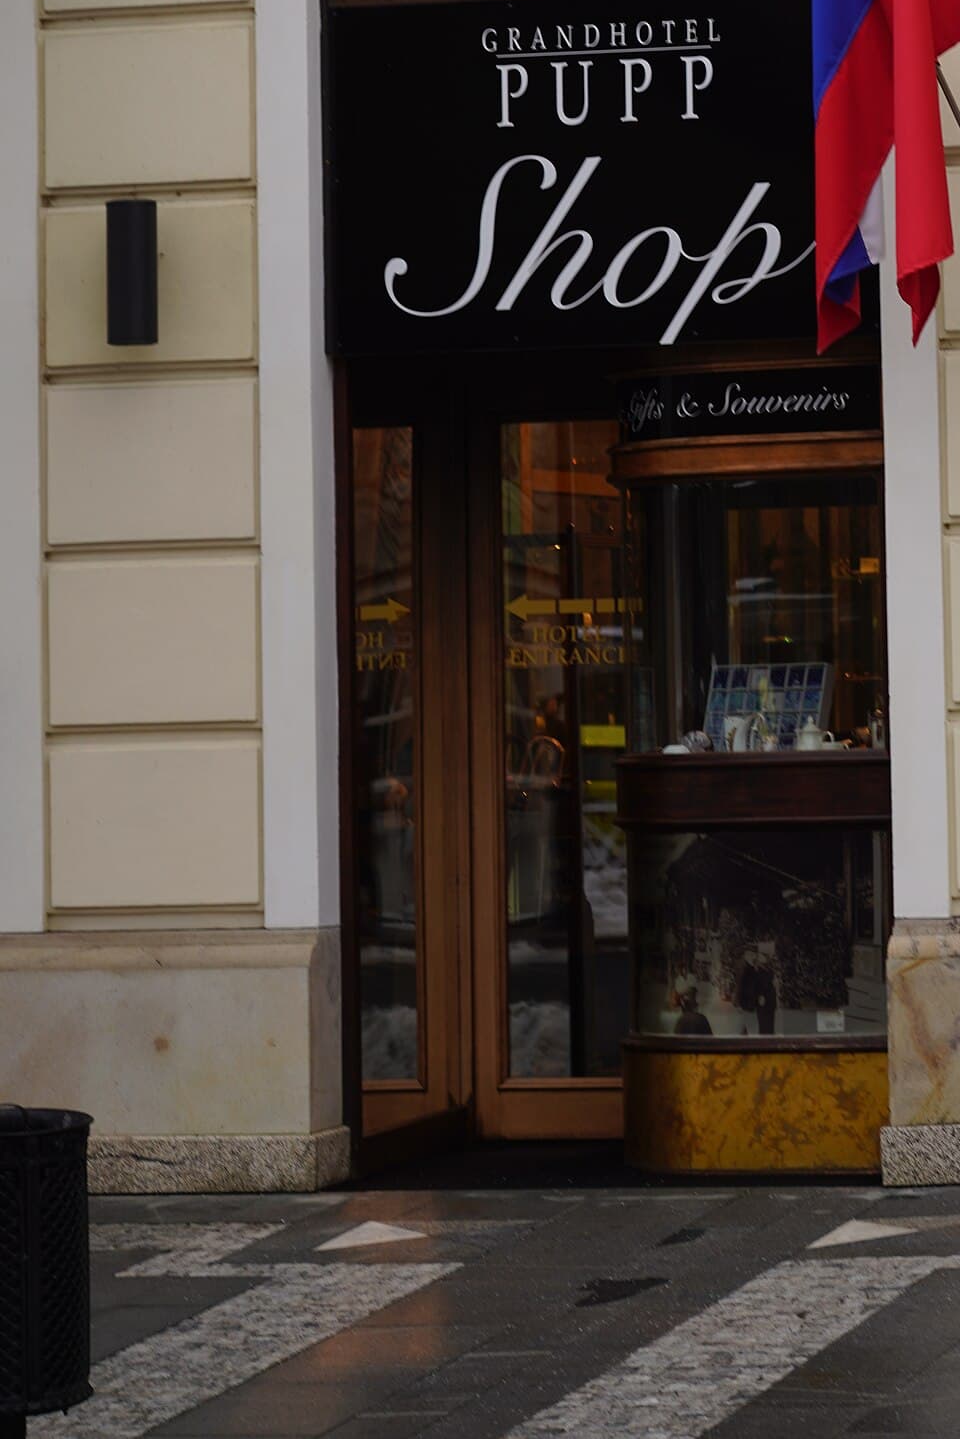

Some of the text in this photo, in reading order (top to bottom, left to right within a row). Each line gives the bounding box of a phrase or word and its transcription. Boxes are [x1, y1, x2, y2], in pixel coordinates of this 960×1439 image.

[481, 18, 720, 53] GRANDHOTEL
[496, 55, 714, 127] PUPP
[385, 155, 815, 345] Shop
[677, 392, 703, 418] &
[708, 382, 850, 417] Souvenirs
[532, 625, 607, 643] HOTEL
